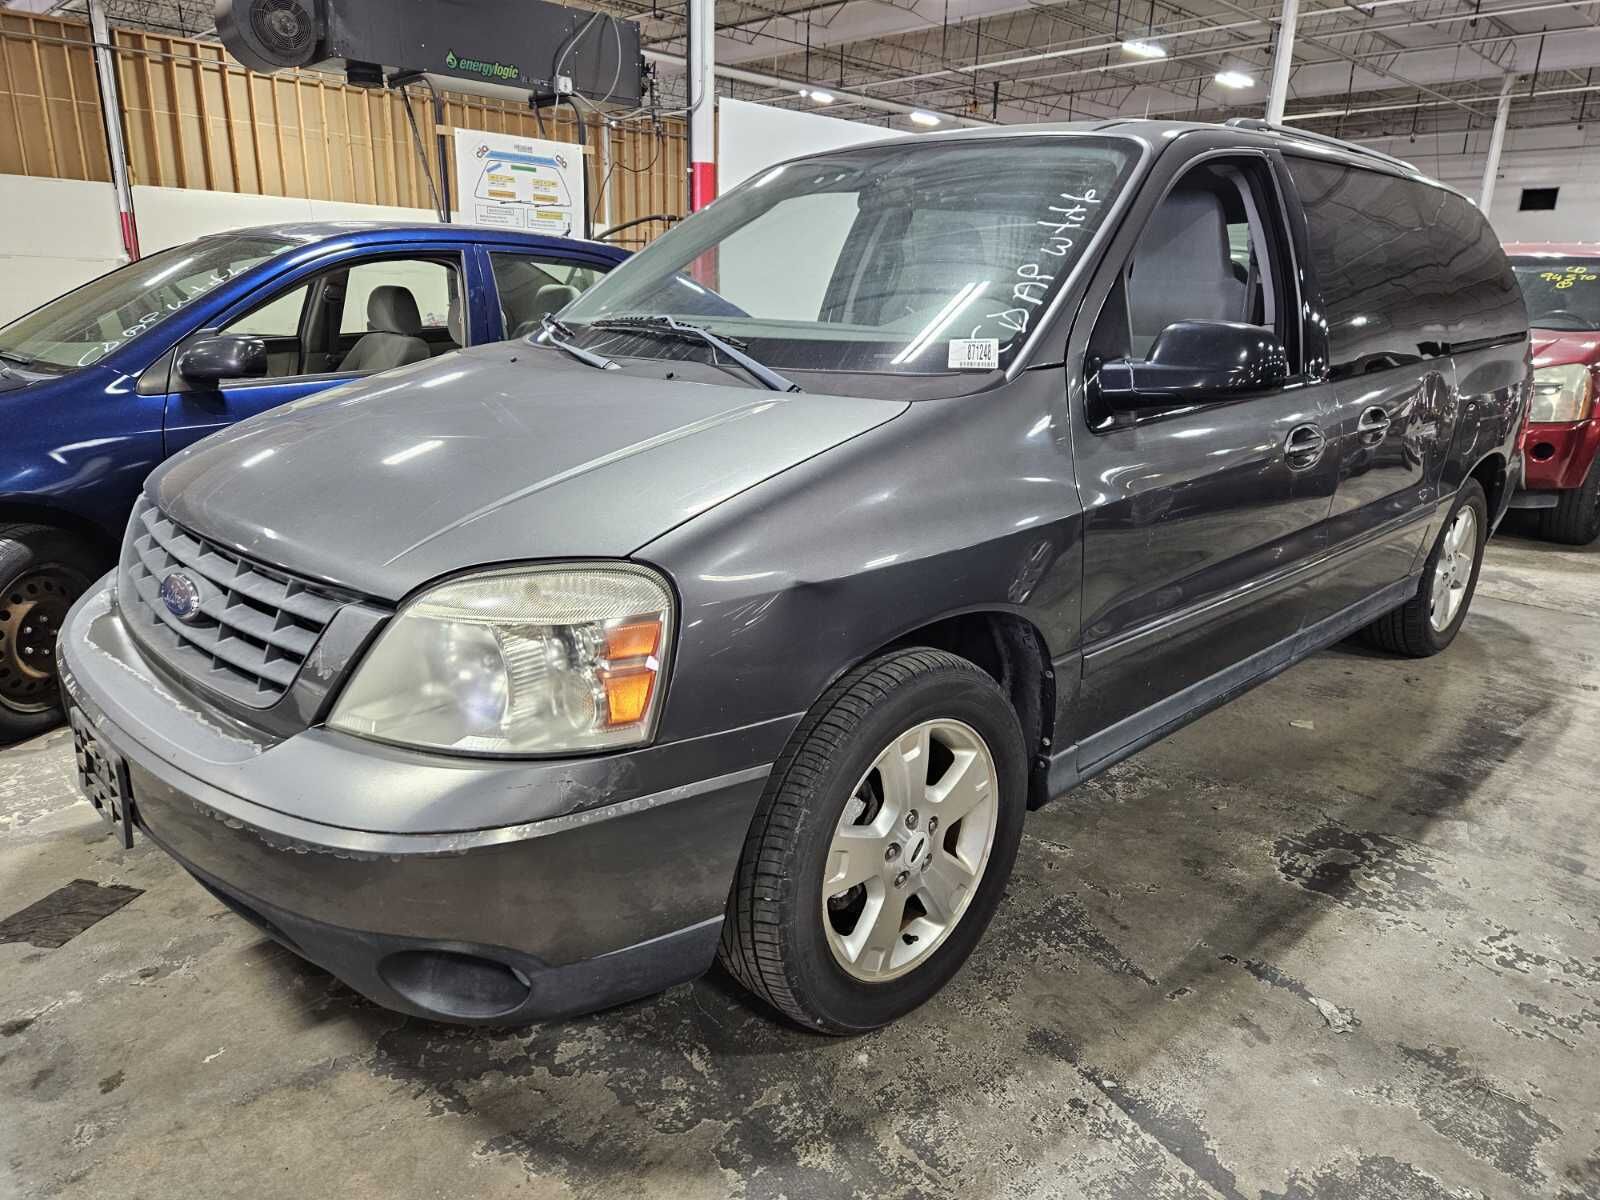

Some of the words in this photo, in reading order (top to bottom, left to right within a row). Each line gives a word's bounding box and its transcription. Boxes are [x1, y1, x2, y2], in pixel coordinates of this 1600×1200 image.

[459, 58, 519, 79] energylogic
[1013, 263, 1054, 305] AP
[967, 343, 992, 361] 871248
